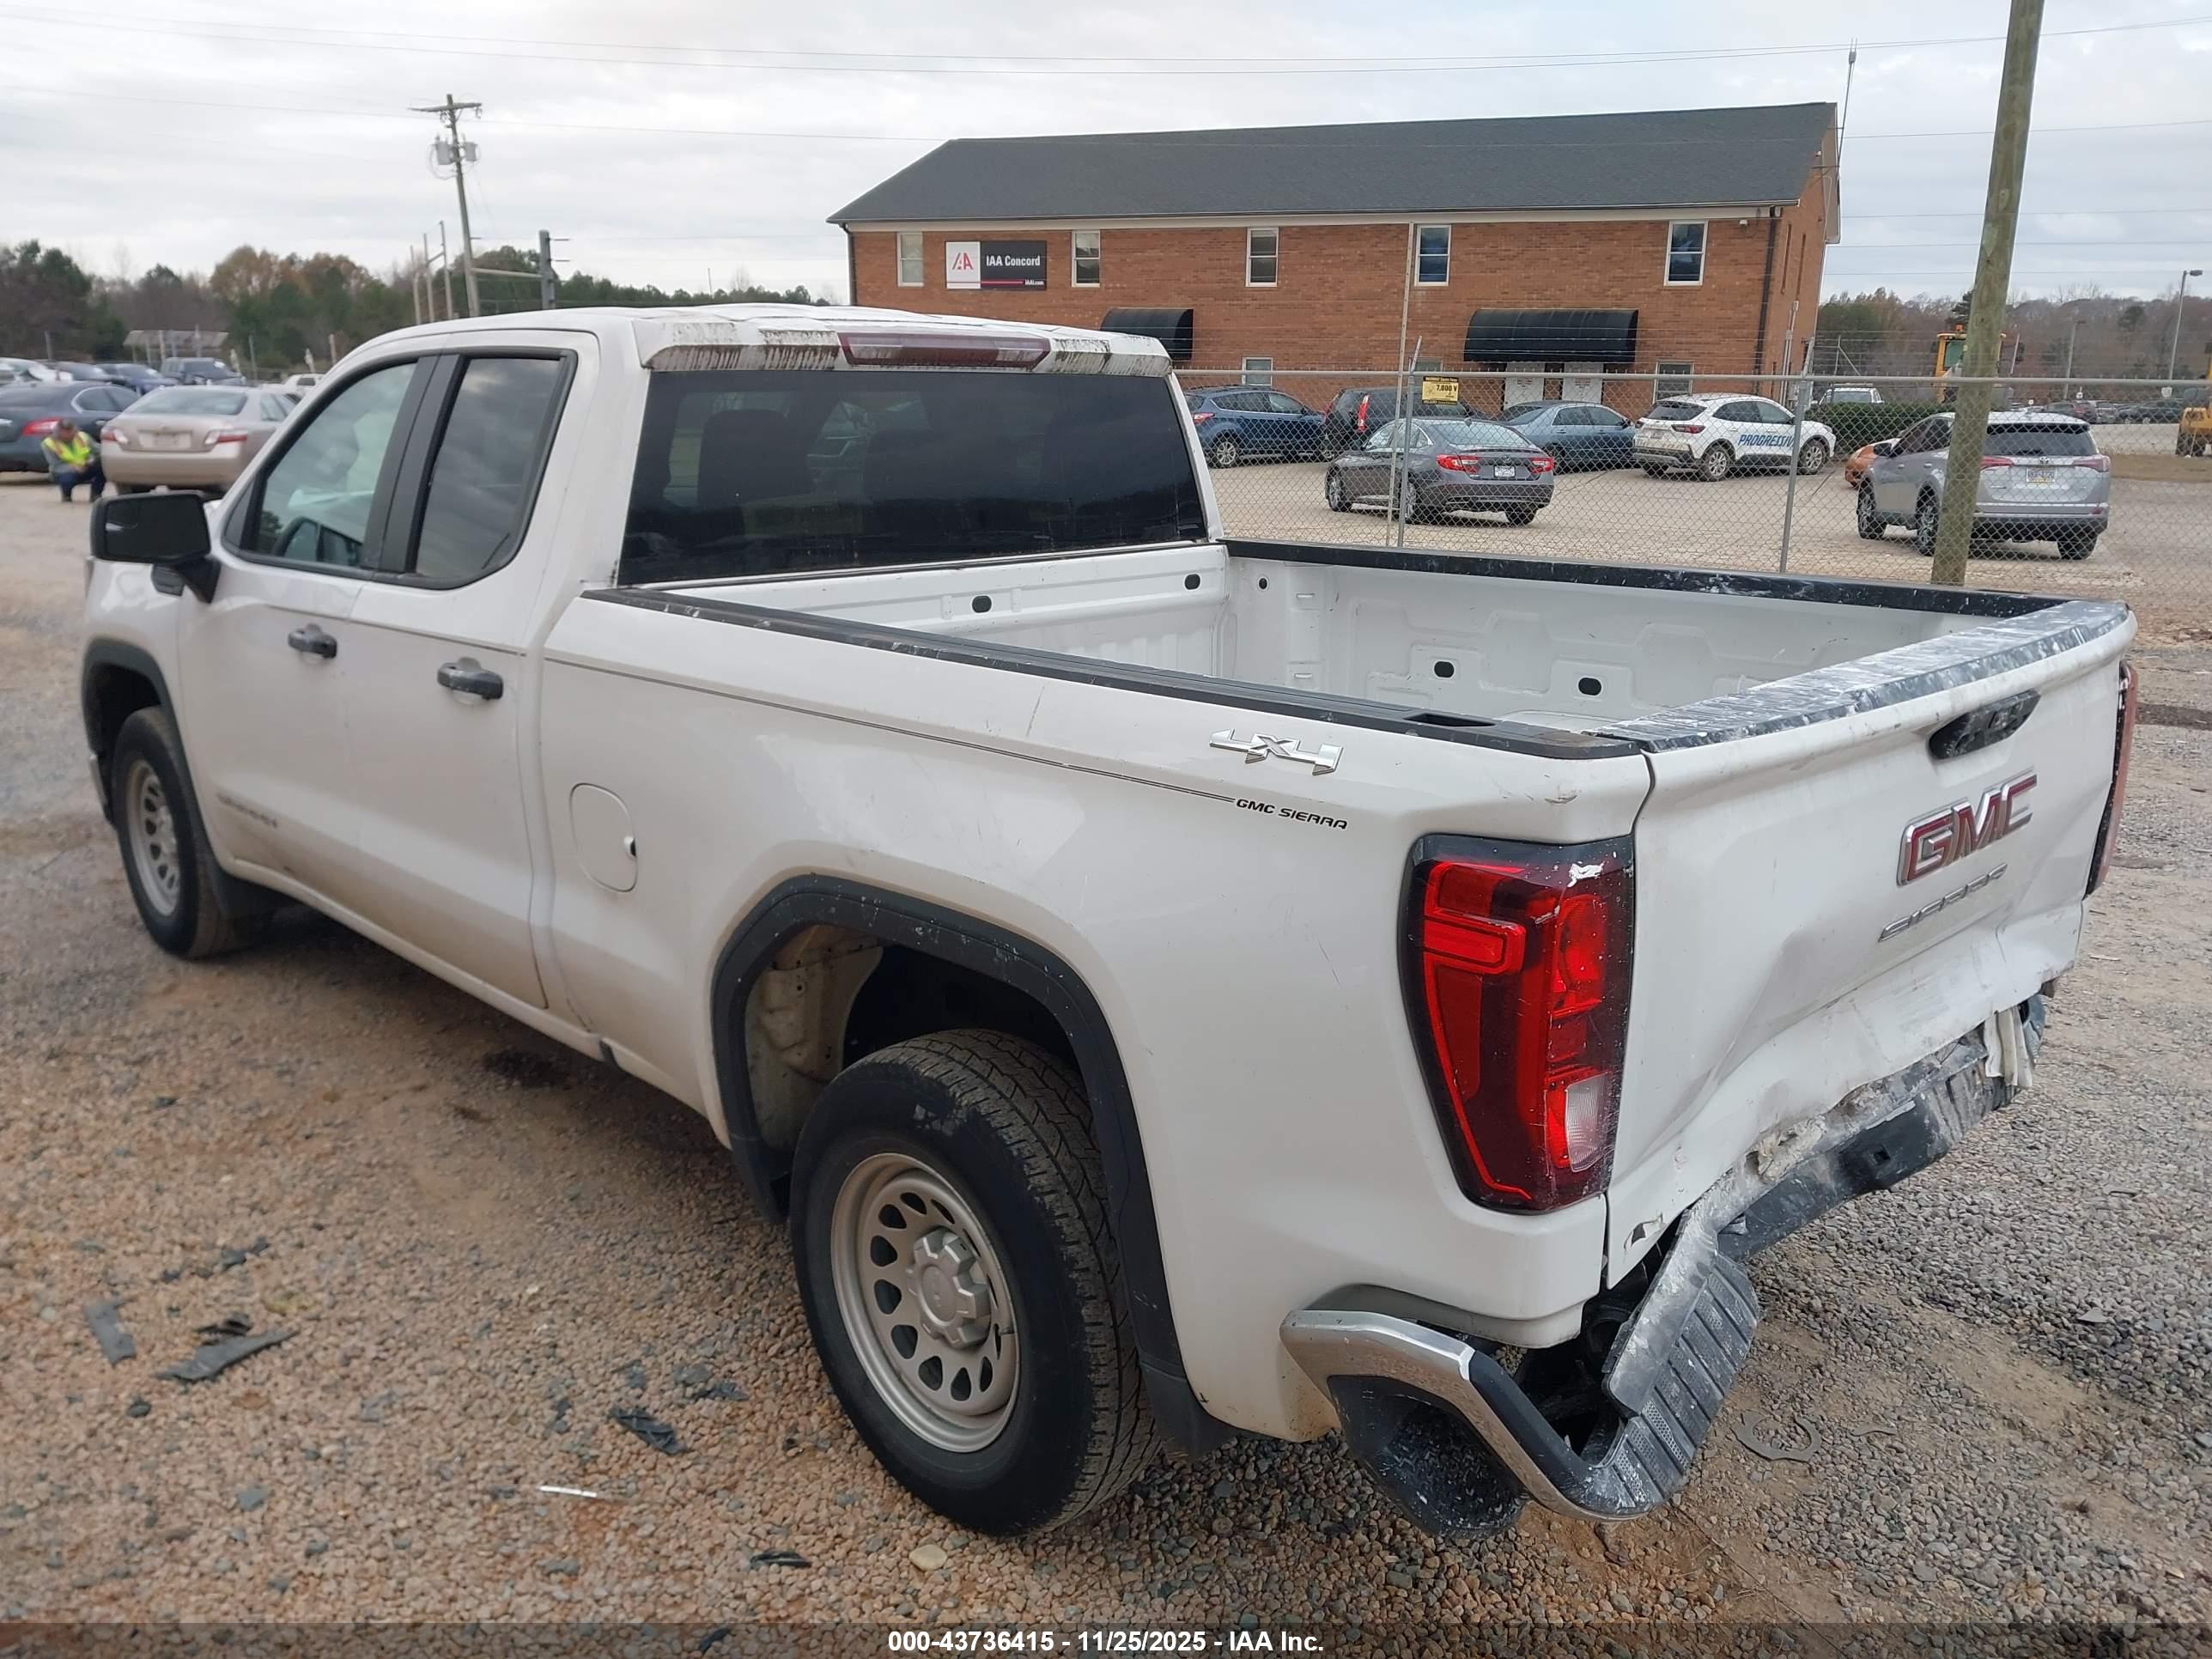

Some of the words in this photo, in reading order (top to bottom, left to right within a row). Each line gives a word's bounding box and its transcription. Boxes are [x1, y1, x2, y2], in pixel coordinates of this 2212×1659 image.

[986, 255, 1003, 266] IAA
[1005, 255, 1041, 266] Concord
[1738, 434, 1795, 447] PROGRESSIV
[1236, 798, 1276, 814] GMC
[1278, 807, 1348, 830] SIERRA
[1896, 771, 2038, 887] GMC
